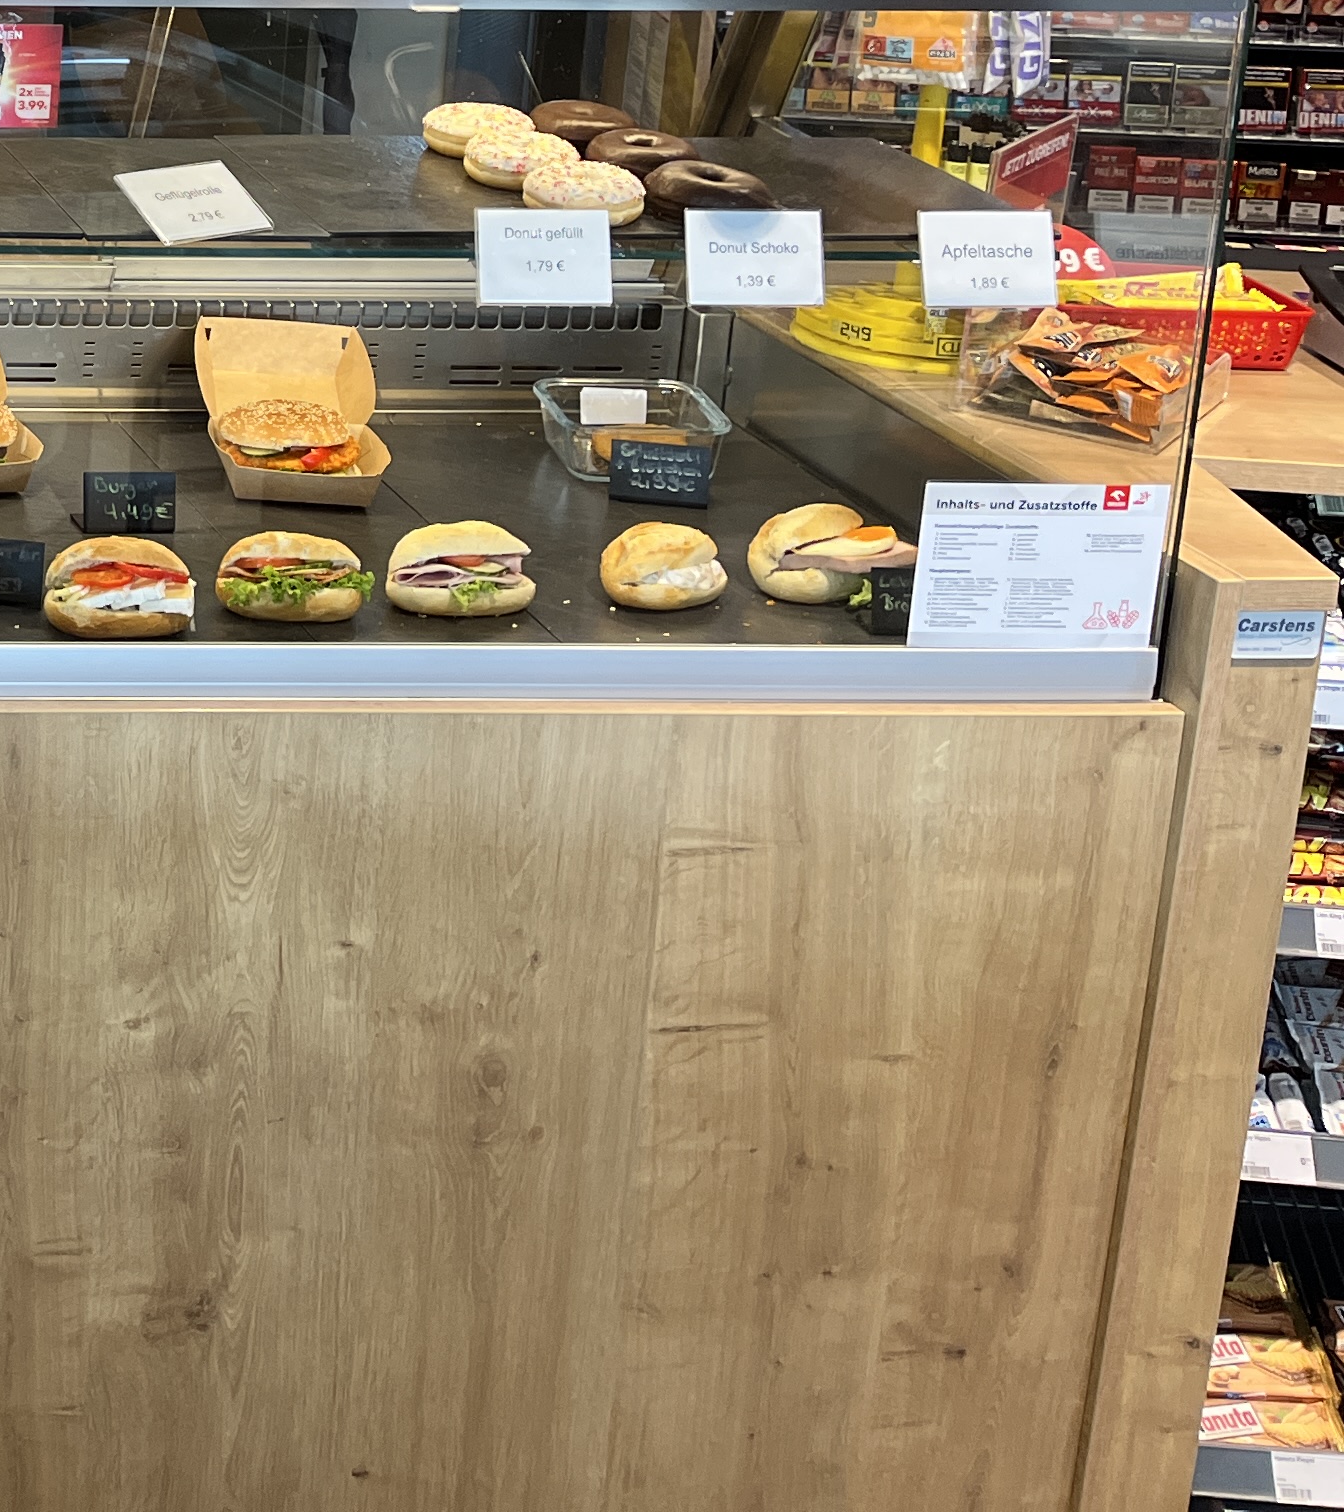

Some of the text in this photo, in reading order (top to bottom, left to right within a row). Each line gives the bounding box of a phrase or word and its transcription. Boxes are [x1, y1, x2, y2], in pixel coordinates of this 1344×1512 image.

[19, 88, 32, 96] 2x
[1001, 150, 1028, 178] JETZT
[1136, 175, 1177, 185] BURTON
[154, 184, 222, 201] Geflügelrolle
[504, 225, 584, 242] Donut gefüllt
[708, 240, 799, 254] Donut Schoko
[942, 243, 1033, 262] Apfeltasche
[526, 260, 566, 274] 1,79 €
[736, 274, 776, 288] 1,39 €
[970, 276, 1010, 290] 1,89 €
[840, 322, 872, 341] 2,49
[936, 498, 1097, 511] Inhalts- und Zusatzstoffe
[1238, 619, 1315, 632] Carstens
